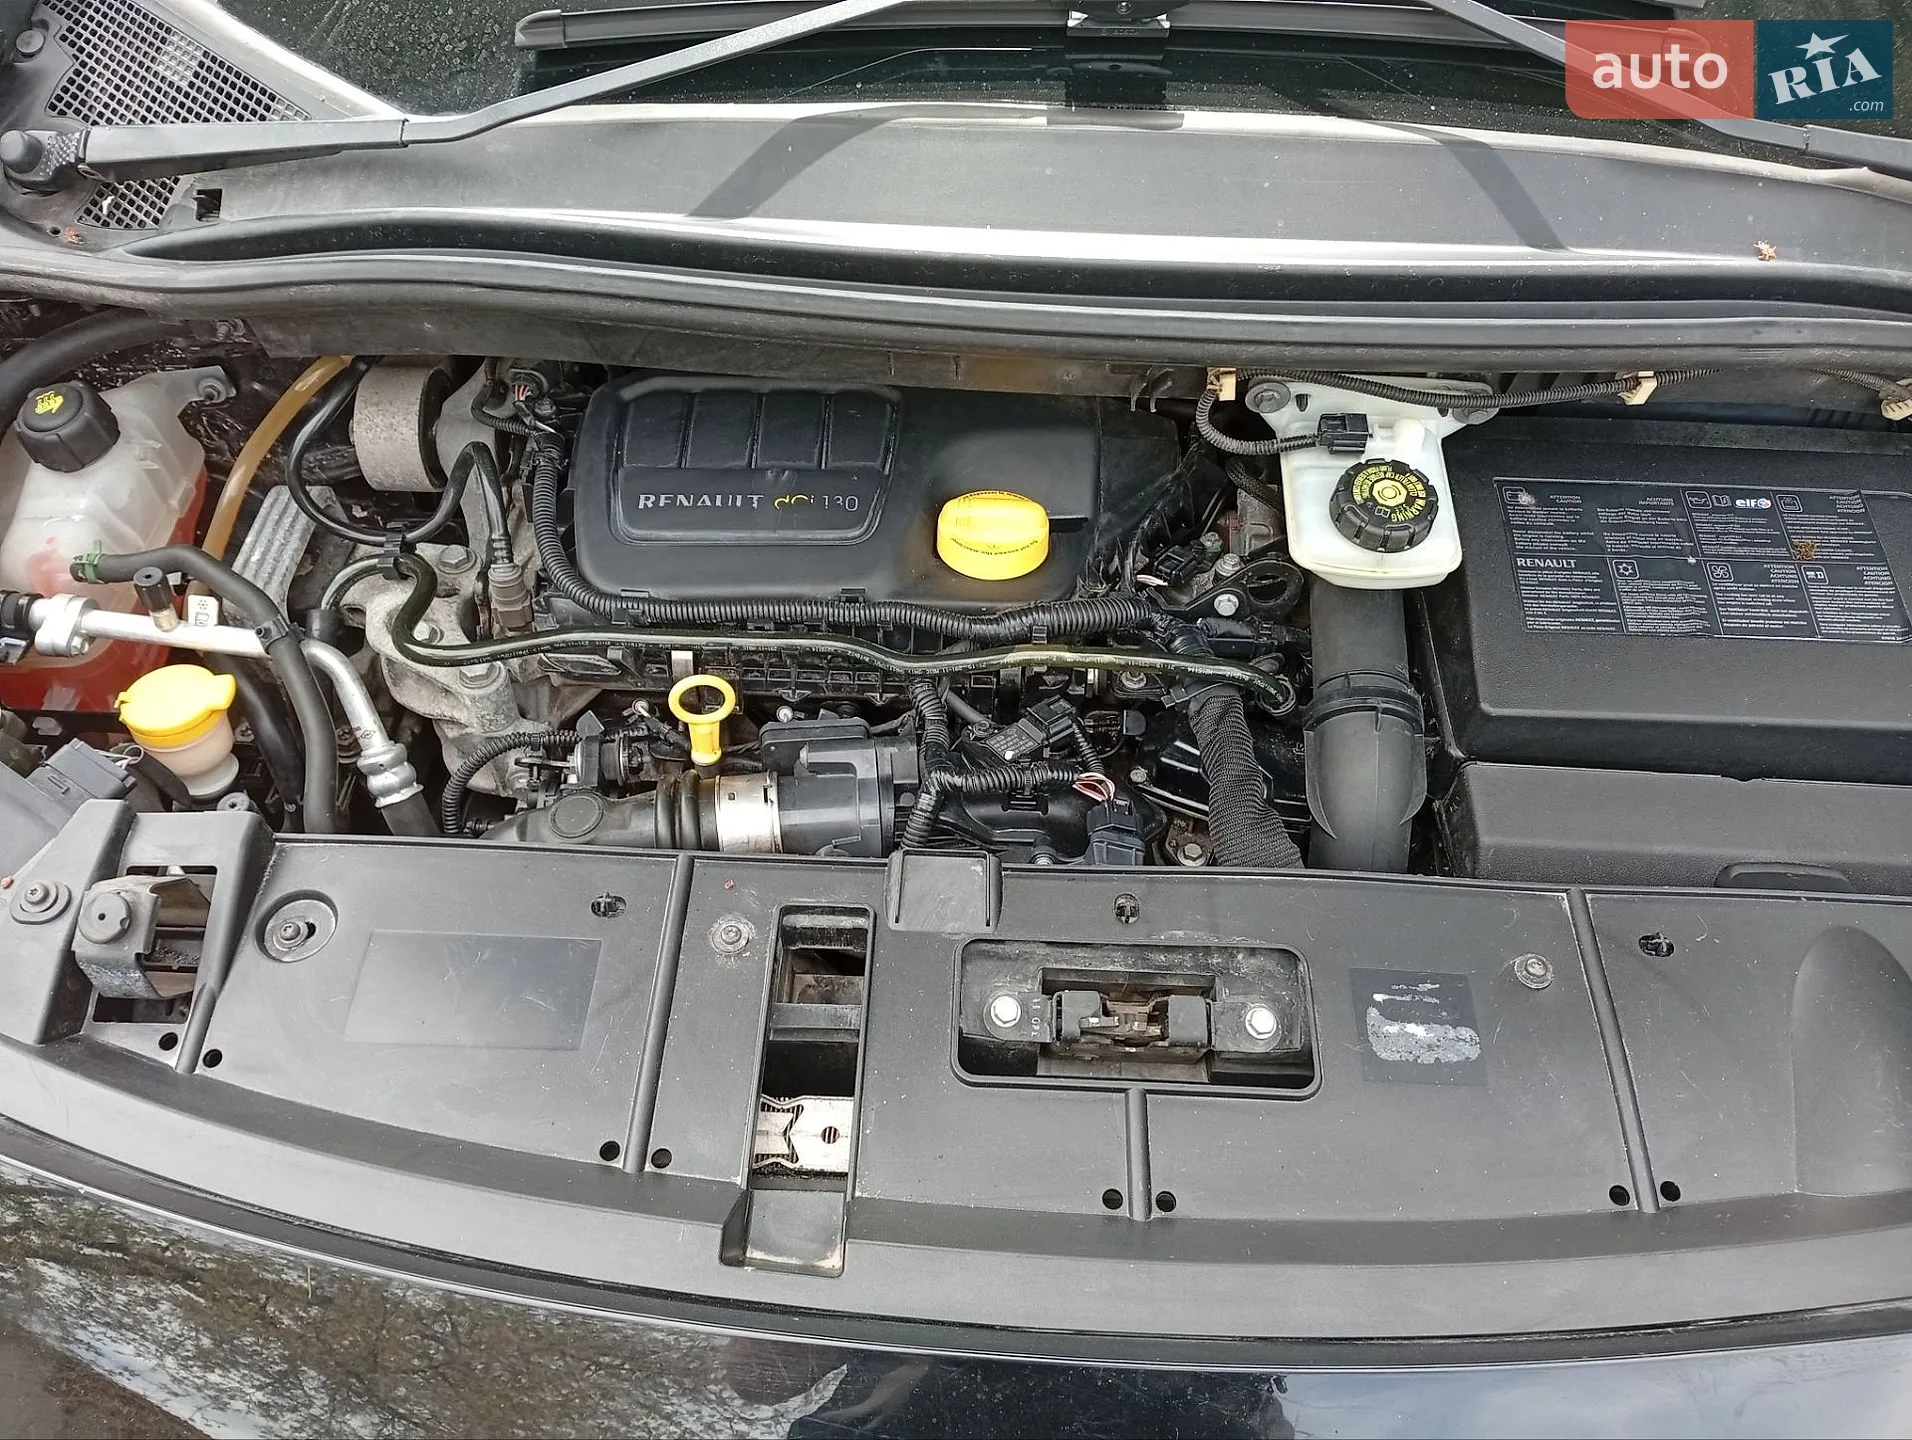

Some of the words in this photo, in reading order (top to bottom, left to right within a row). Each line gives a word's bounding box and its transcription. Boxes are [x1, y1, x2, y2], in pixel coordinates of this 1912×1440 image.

[638, 494, 765, 509] RENAULT
[1391, 498, 1427, 522] WARNING
[1516, 558, 1576, 568] RENAULT
